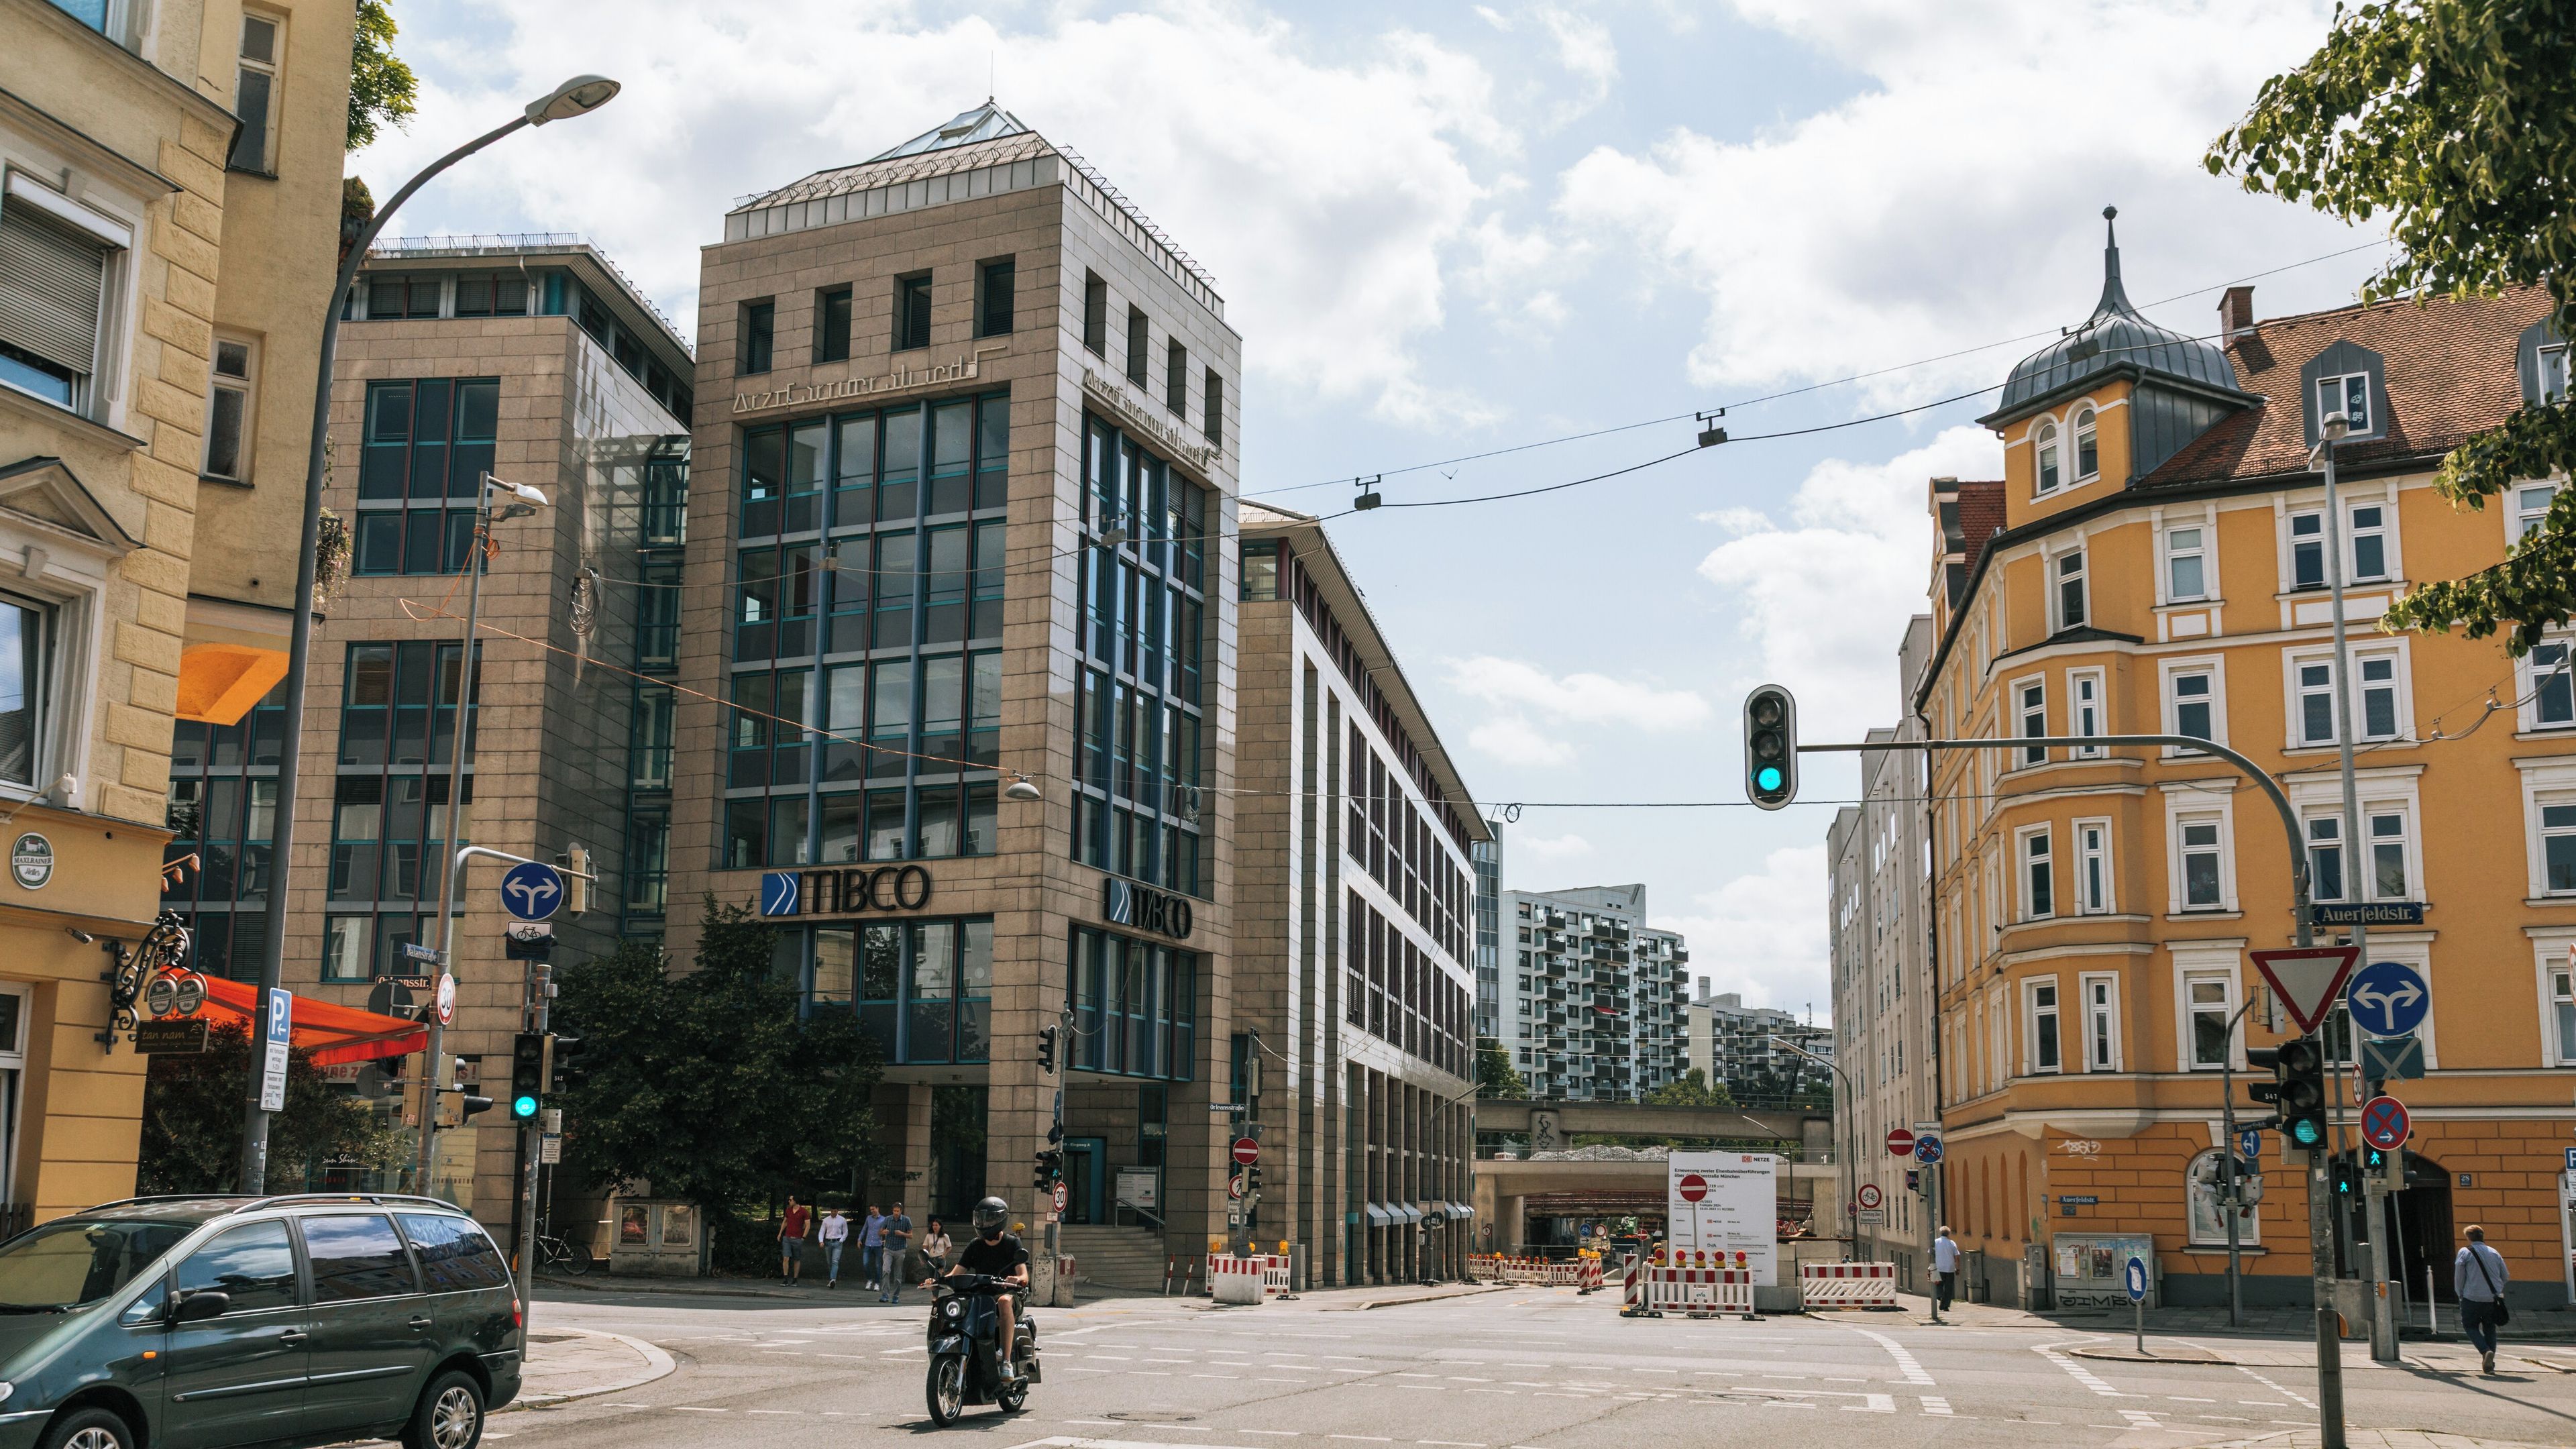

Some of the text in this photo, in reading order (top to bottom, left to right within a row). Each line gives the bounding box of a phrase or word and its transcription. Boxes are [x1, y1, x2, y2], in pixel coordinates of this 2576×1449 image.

[804, 865, 930, 913] TIBCO
[1131, 884, 1193, 939] TIBCO
[2322, 906, 2413, 923] Auerfeldstr.
[407, 945, 437, 961] Balanstraße
[441, 988, 451, 1010] 30
[142, 1030, 159, 1040] tan
[2354, 1076, 2361, 1095] 30
[1056, 1191, 1065, 1203] 30
